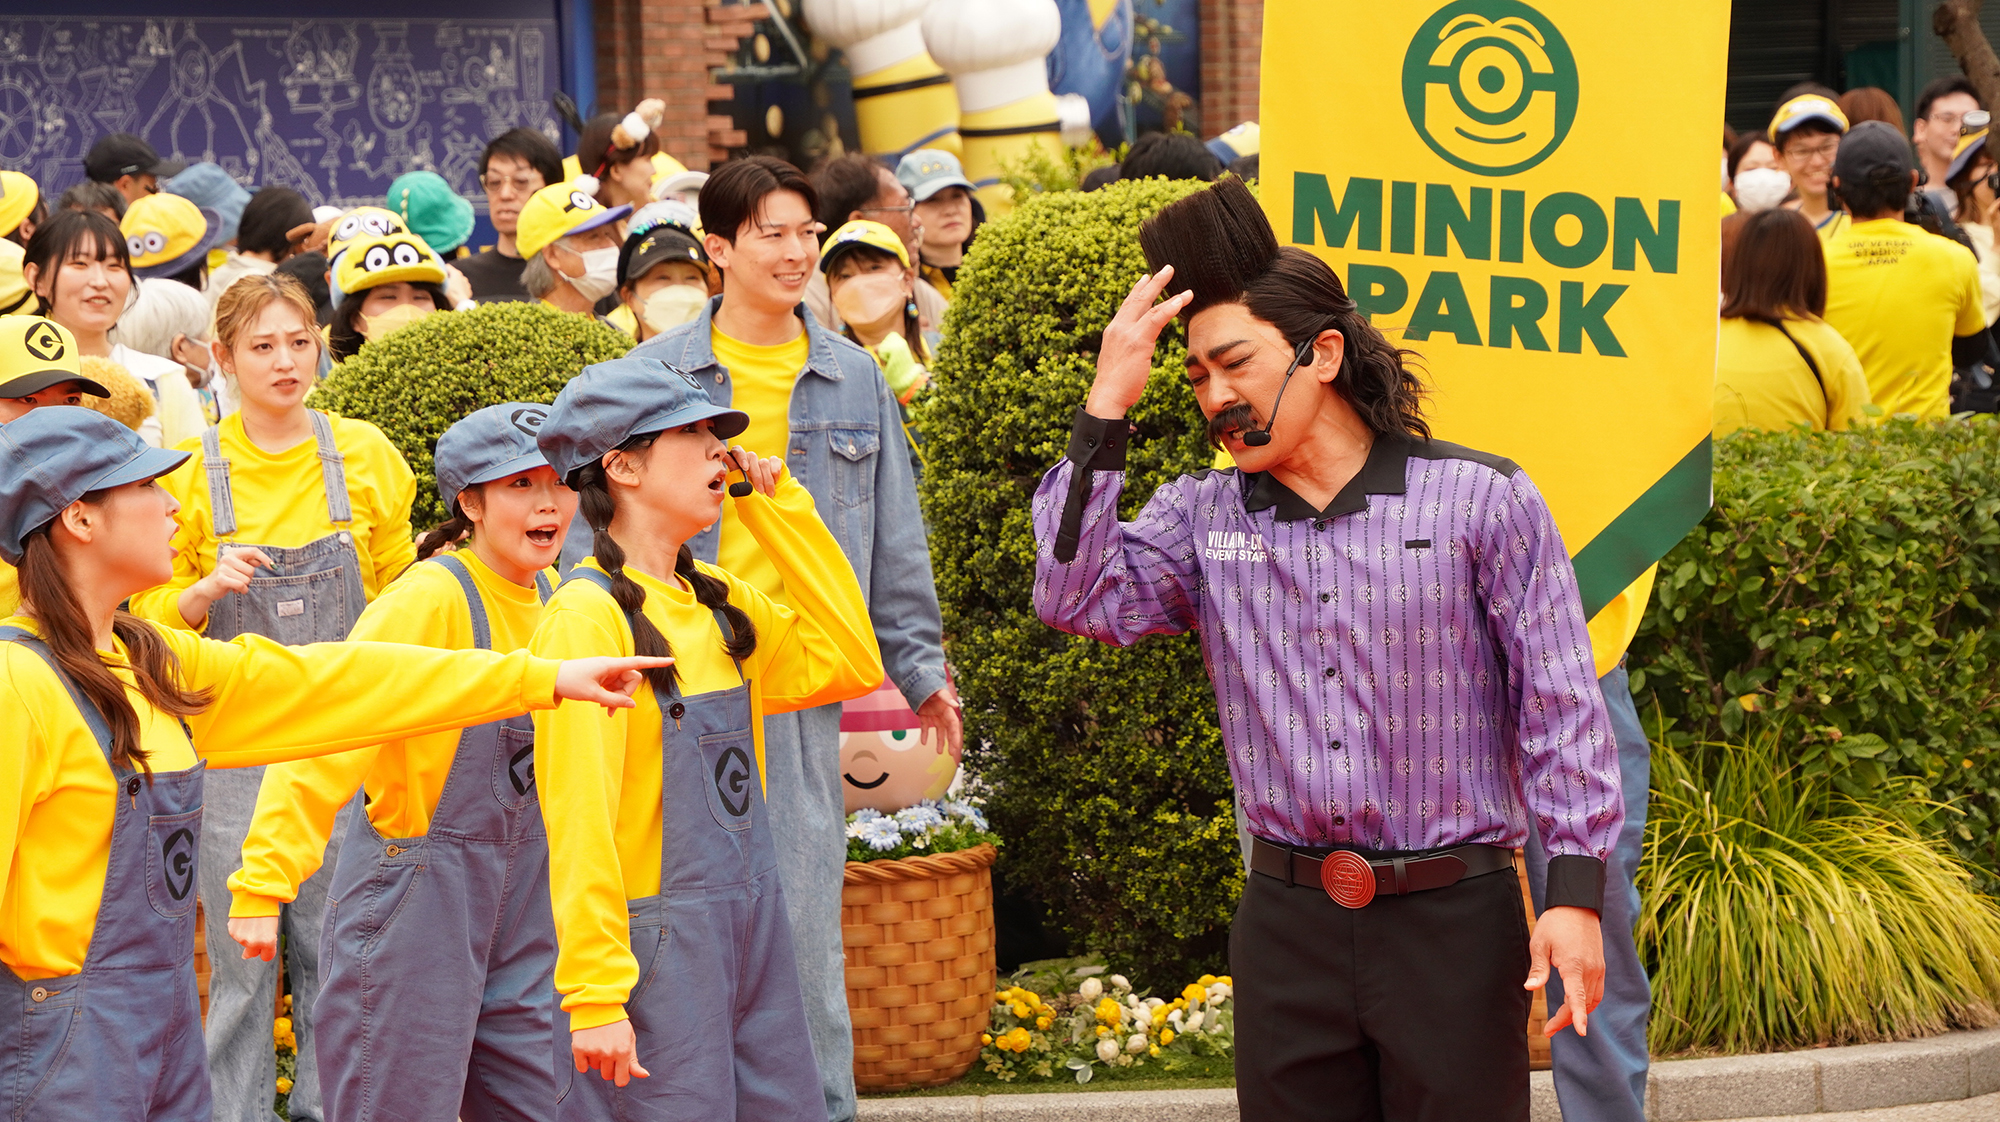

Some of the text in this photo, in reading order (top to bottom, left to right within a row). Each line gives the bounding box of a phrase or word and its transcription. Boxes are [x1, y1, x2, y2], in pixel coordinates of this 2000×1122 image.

[1292, 171, 1681, 274] MINION
[1849, 240, 1912, 248] UNVERSAL
[1865, 256, 1898, 266] APAN
[1347, 263, 1630, 358] PARK
[1206, 548, 1238, 560] EVENT
